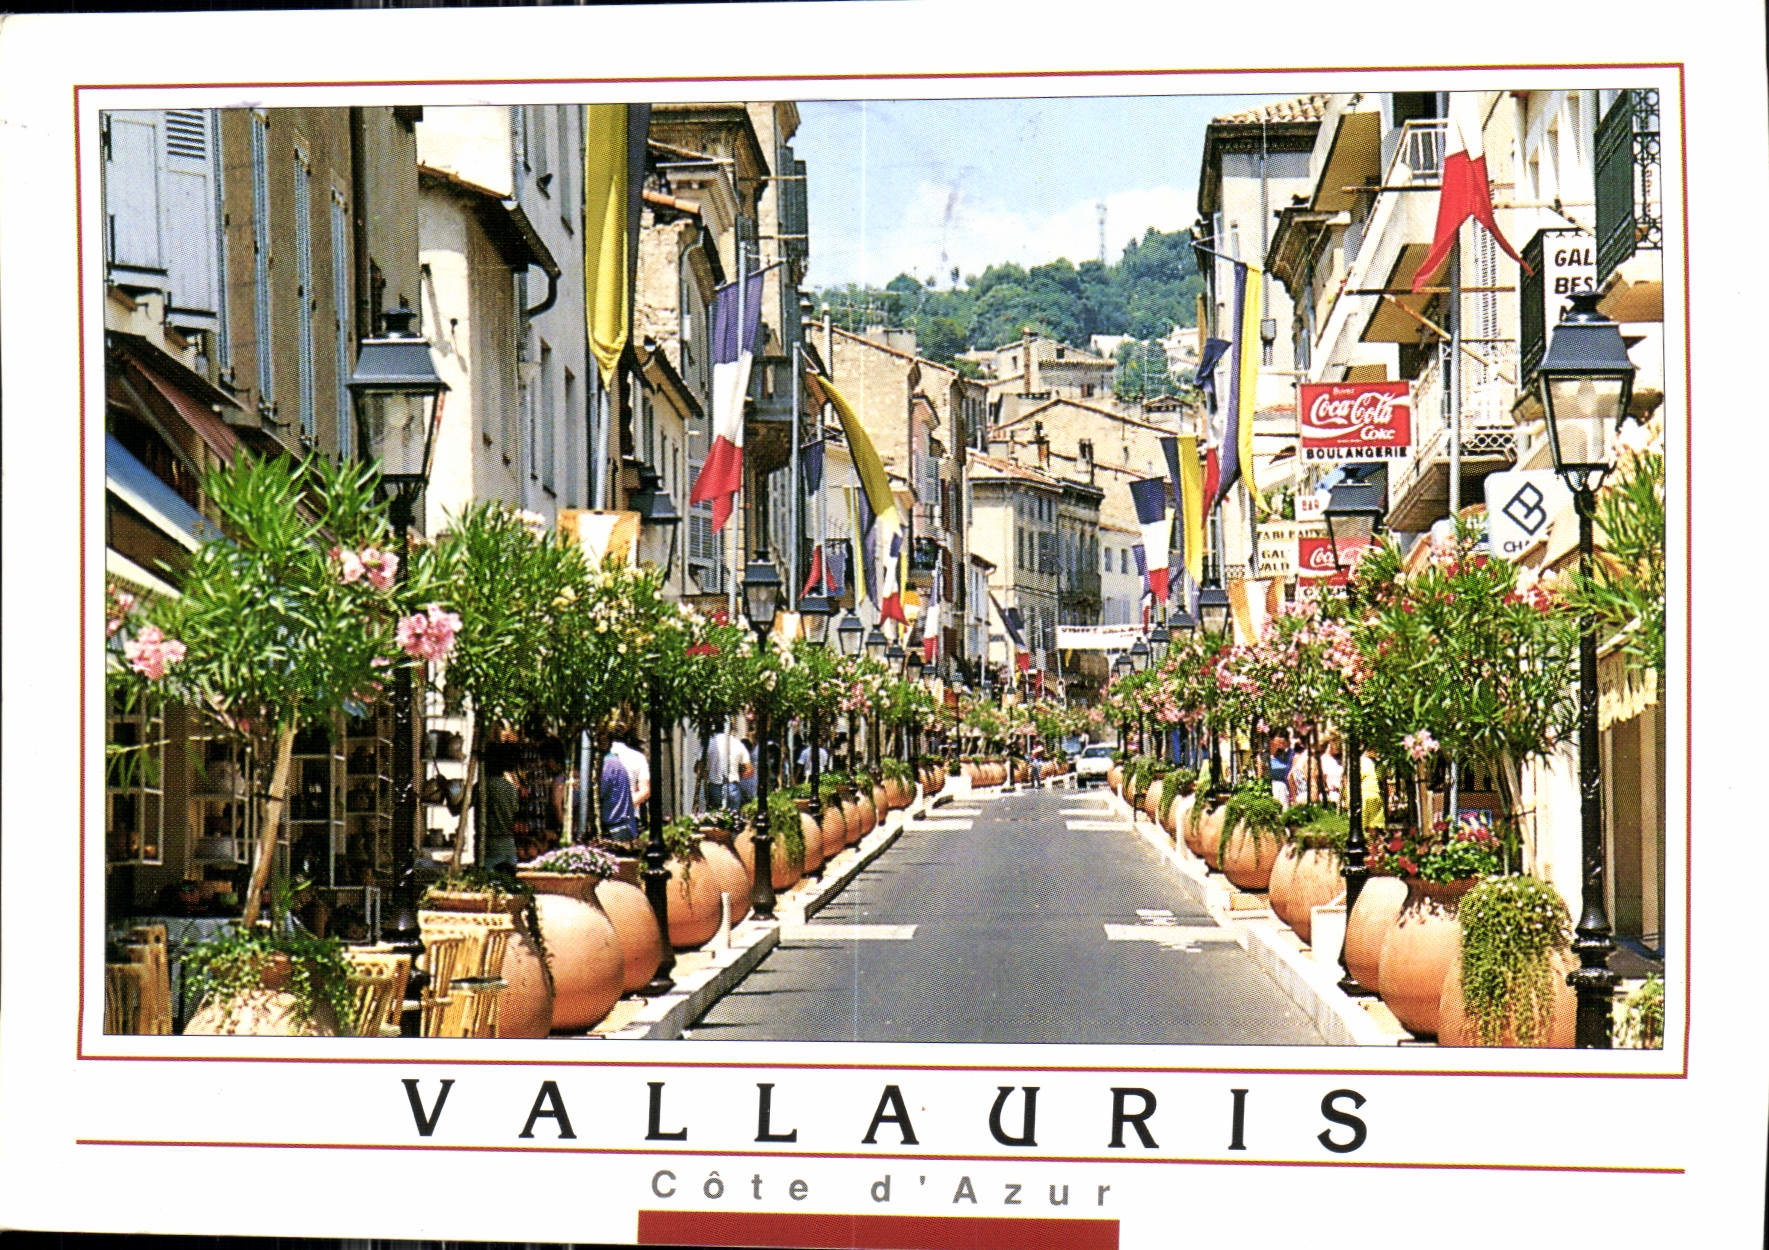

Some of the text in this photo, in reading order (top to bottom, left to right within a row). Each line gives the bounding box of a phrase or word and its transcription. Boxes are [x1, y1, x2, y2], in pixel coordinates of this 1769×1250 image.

[1310, 392, 1394, 425] Coca-Cola
[1360, 424, 1396, 441] Coke
[1306, 446, 1407, 459] BOULANGERIE
